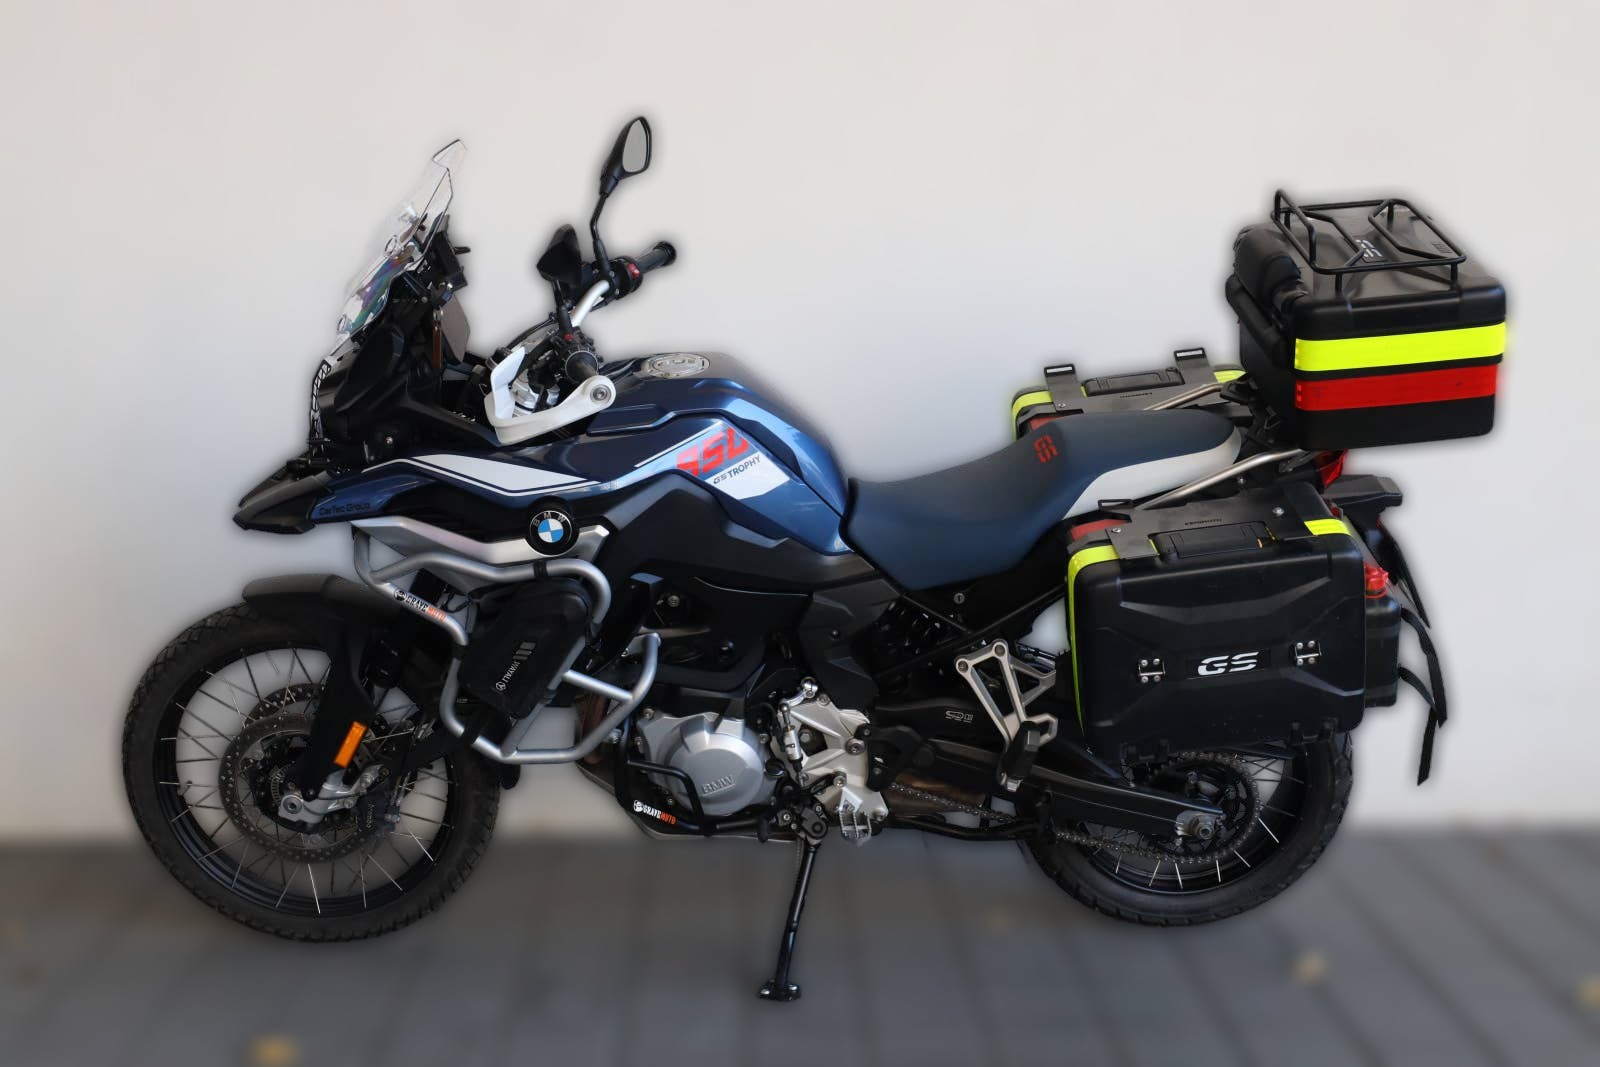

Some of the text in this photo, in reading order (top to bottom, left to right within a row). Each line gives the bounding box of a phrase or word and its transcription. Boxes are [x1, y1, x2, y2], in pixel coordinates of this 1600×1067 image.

[1033, 434, 1059, 464] GS
[713, 454, 761, 485] GS TROPHY
[532, 511, 566, 527] BMW
[1197, 651, 1259, 676] GS
[702, 774, 735, 794] BMW
